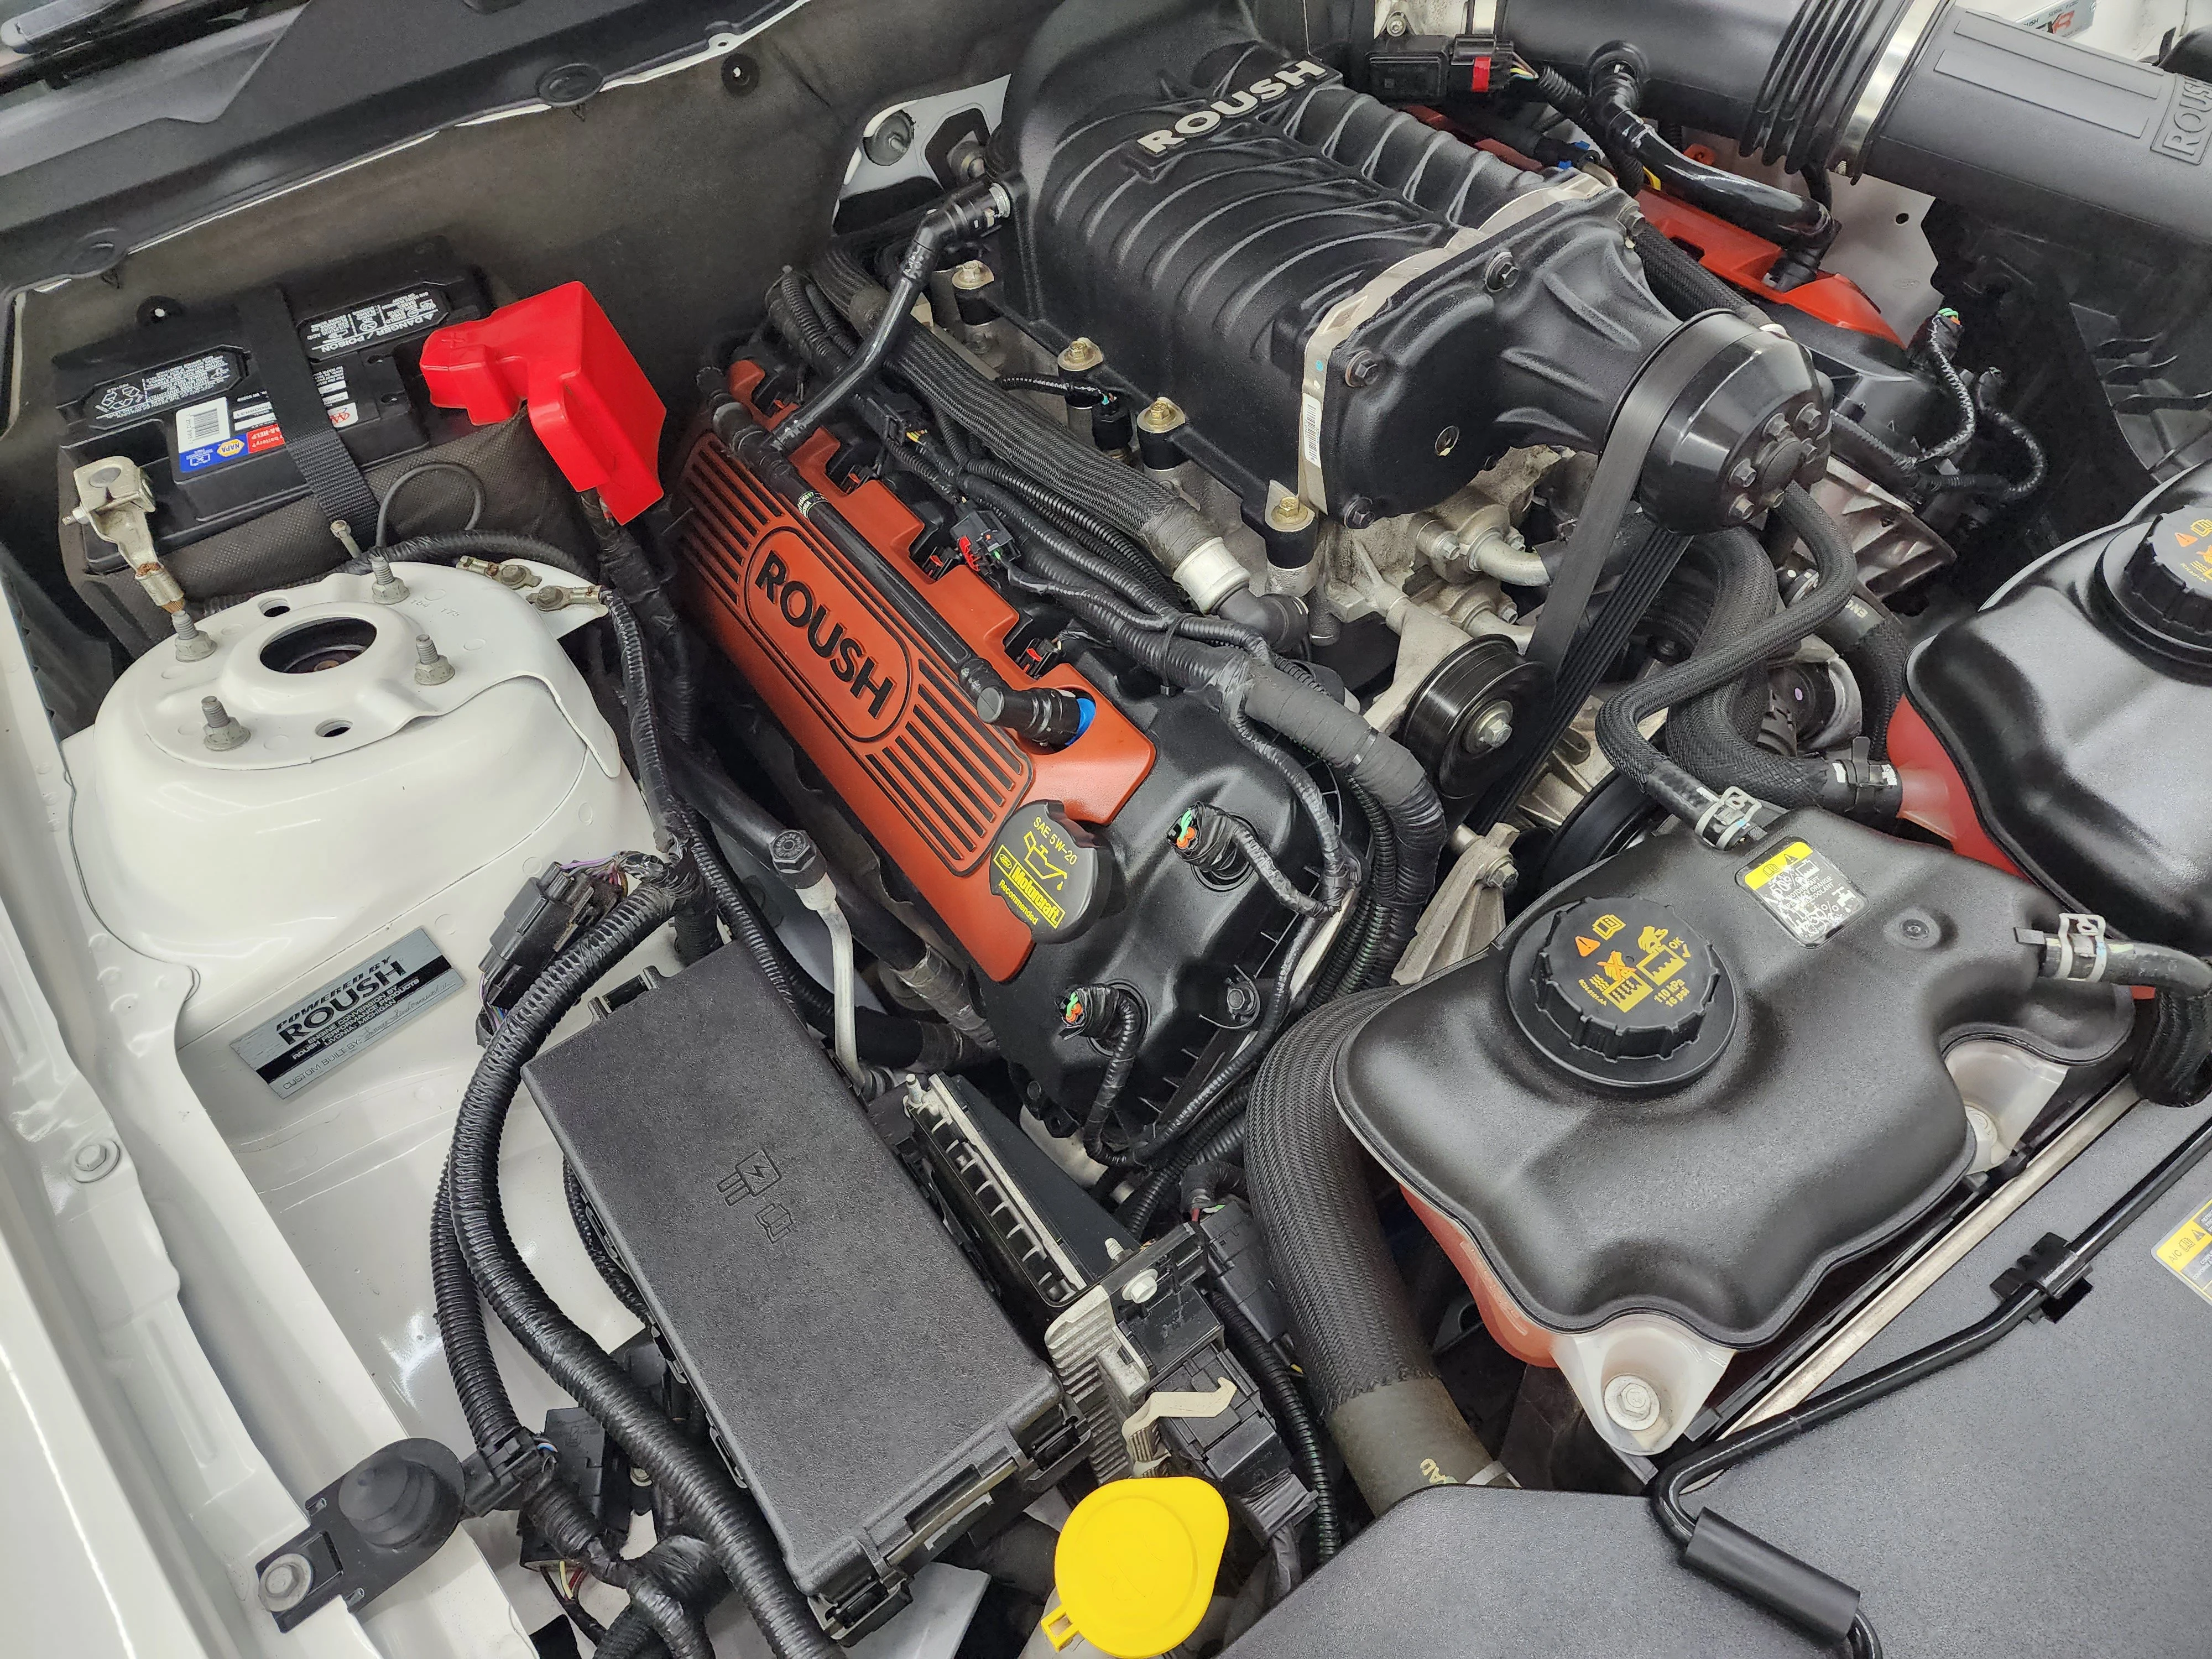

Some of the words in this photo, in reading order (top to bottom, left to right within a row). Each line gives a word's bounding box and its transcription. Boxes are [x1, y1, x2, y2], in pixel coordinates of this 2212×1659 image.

[1137, 60, 1326, 154] ROUSH
[321, 335, 364, 353] POISON
[375, 316, 423, 336] DANGER
[221, 442, 240, 453] NAPA
[755, 550, 897, 719] ROUSH
[1031, 816, 1052, 838] SAE
[1047, 833, 1078, 866] 5W-20
[997, 879, 1040, 925] Recommended
[1010, 866, 1063, 925] Motorcraft
[1809, 874, 1833, 893] ORANGE
[1667, 934, 1684, 951] OK
[274, 973, 366, 1031] POWERED
[367, 954, 393, 974] BY
[278, 958, 407, 1047] ROUSH
[357, 998, 397, 1026] MICHIGAN
[1652, 987, 1671, 1005] 110
[1667, 976, 1686, 994] kPa
[1665, 995, 1678, 1009] 16
[1676, 985, 1690, 1002] psi
[292, 1040, 320, 1060] ROUSH
[320, 1003, 379, 1042] PERFORMANCE
[378, 977, 420, 1006] PRODUCTS
[307, 1022, 337, 1045] ENGINE
[337, 992, 387, 1026] CONVERSION
[385, 984, 399, 995] BY
[282, 1062, 321, 1091] CUSTOM
[321, 1047, 346, 1066] BUILT
[2168, 1248, 2182, 1263] A/C
